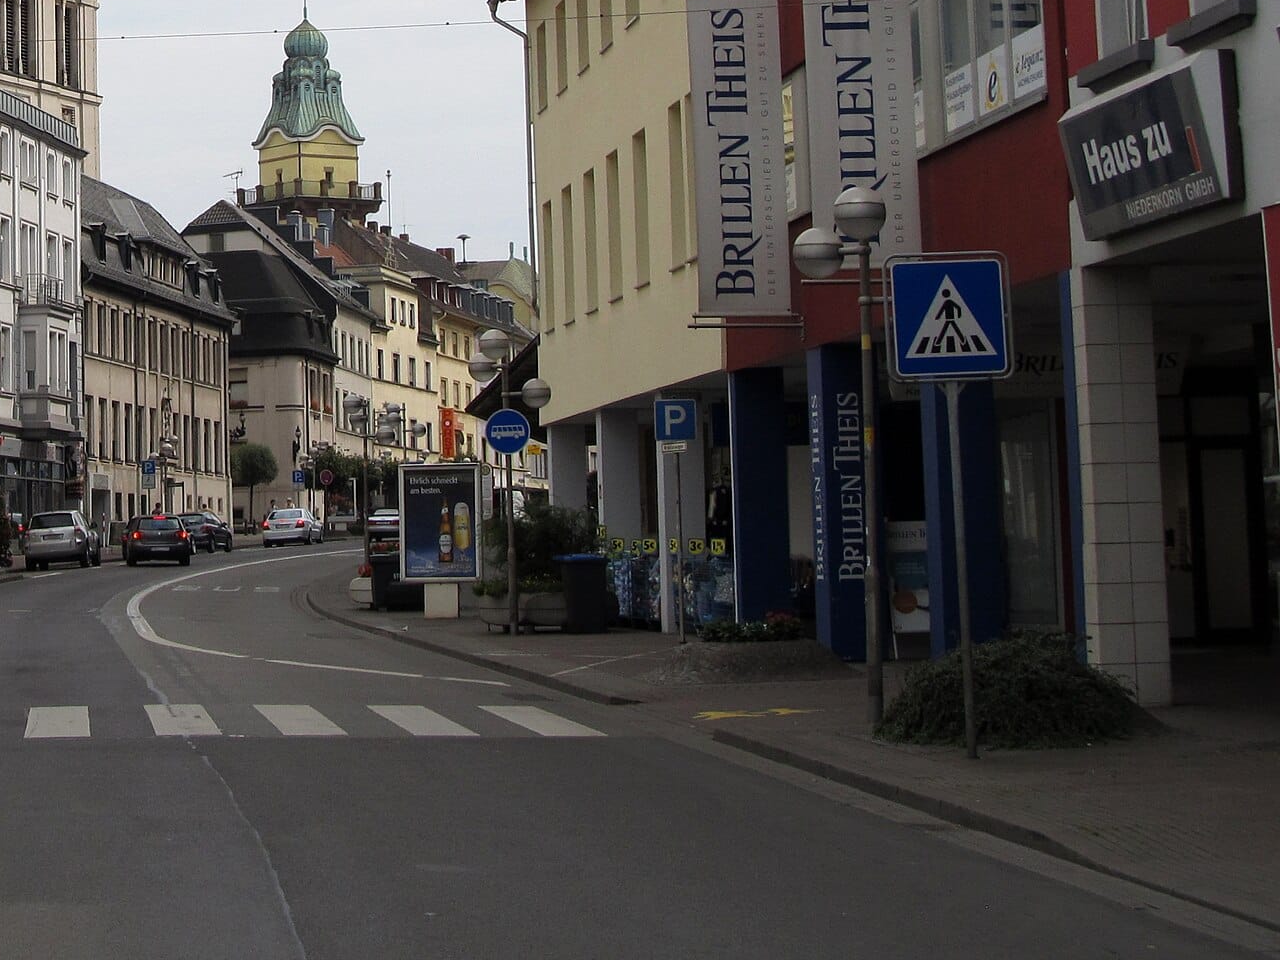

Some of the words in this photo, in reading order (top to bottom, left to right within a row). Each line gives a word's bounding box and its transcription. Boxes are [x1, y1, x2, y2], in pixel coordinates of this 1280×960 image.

[756, 12, 766, 57] SEHEN
[884, 5, 894, 36] GUT
[706, 8, 748, 127] THEIS
[759, 65, 768, 81] ZU
[887, 46, 896, 72] IST
[760, 90, 769, 118] GUT
[761, 127, 770, 148] IST
[834, 53, 888, 246] ILLEN
[887, 82, 902, 201] UNTERSCHIED
[1081, 134, 1142, 185] Haus
[1142, 121, 1173, 162] zu
[716, 134, 762, 299] BRILLEN
[762, 158, 775, 258] UNTERSCHIED
[1125, 188, 1184, 220] NIEDERKORN
[1185, 176, 1216, 201] GMBH
[895, 213, 905, 244] DER
[767, 269, 776, 296] DER
[1015, 352, 1064, 376] BRIL
[664, 405, 687, 436] P
[833, 392, 861, 471] THEIS
[431, 477, 458, 485] schmeckt
[839, 474, 865, 582] BRILLEN
